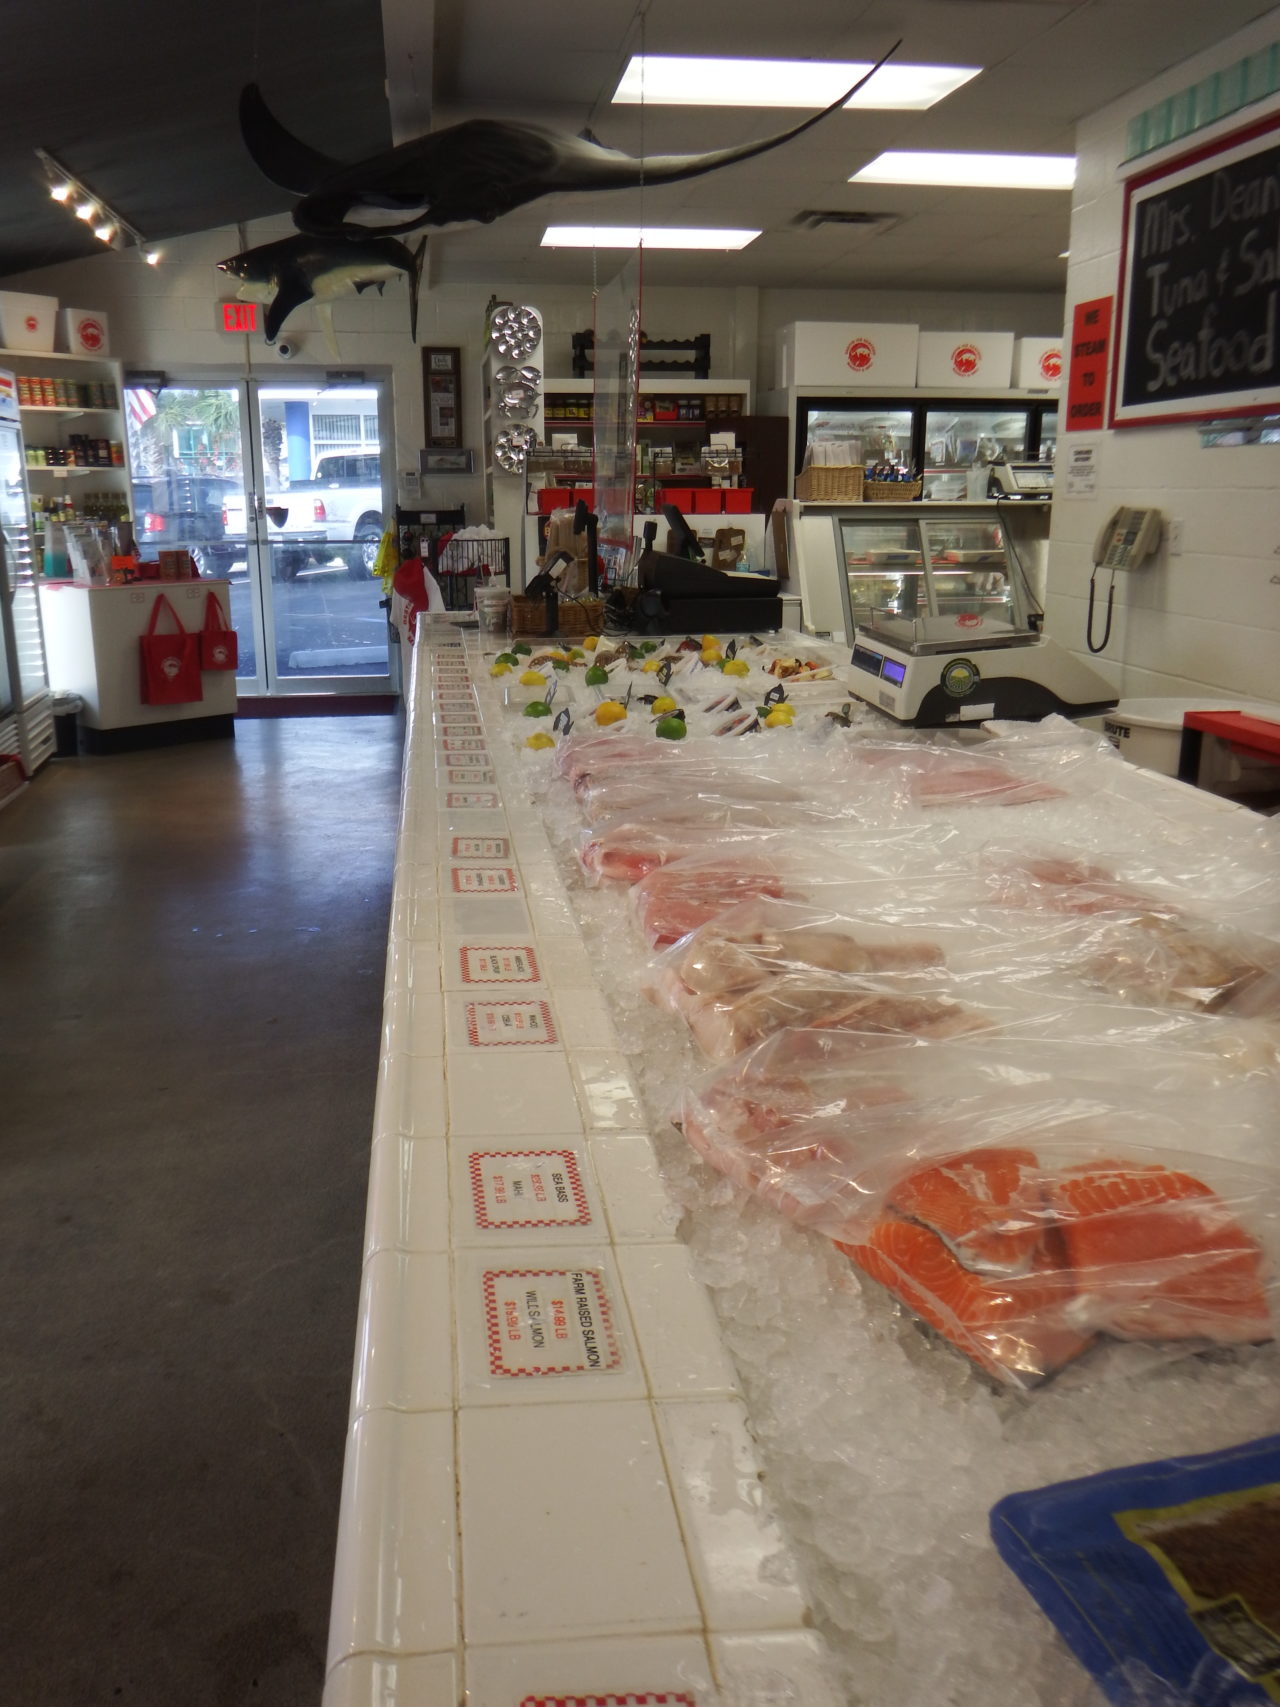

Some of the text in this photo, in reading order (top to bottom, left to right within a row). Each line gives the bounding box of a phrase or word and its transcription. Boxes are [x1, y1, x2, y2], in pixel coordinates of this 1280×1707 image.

[1141, 199, 1196, 259] Mrs.
[1146, 261, 1208, 318] Tuna
[223, 303, 257, 332] EXIT
[1085, 309, 1100, 327] WE
[1074, 338, 1106, 359] STEAM
[1145, 290, 1278, 393] Seafood
[1083, 371, 1096, 388] TO
[1070, 401, 1103, 419] ORDER
[552, 1172, 569, 1203] SEA BASS
[496, 1195, 507, 1203] LB
[571, 1272, 601, 1368] FARM RAISED SALMON
[508, 1329, 521, 1341] LB
[555, 1327, 568, 1339] LB
